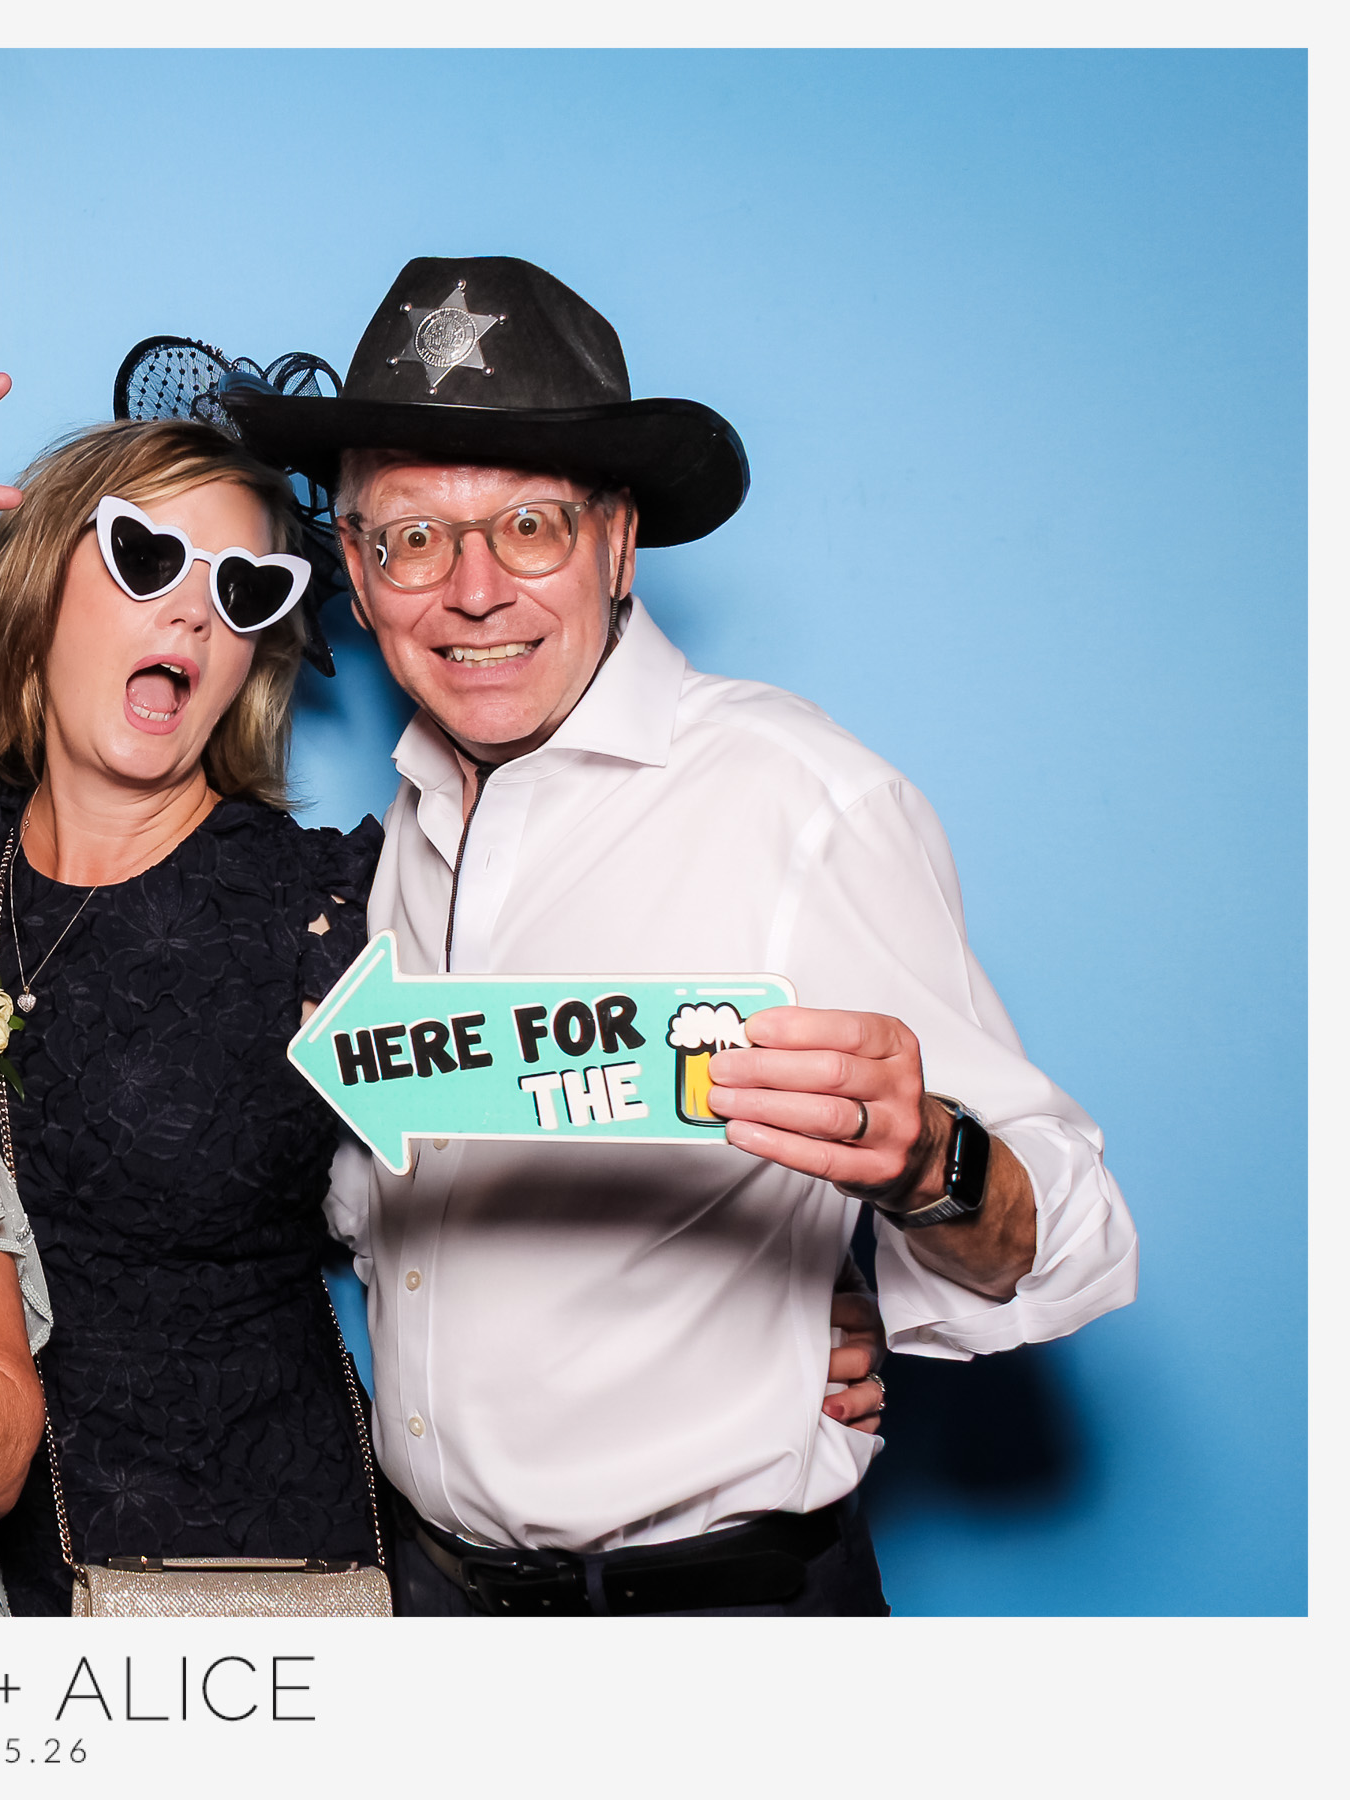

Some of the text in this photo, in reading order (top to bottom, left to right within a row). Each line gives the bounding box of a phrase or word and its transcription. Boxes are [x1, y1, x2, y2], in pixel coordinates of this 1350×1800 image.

[331, 992, 646, 1086] HERE FOR
[517, 1061, 649, 1130] THE
